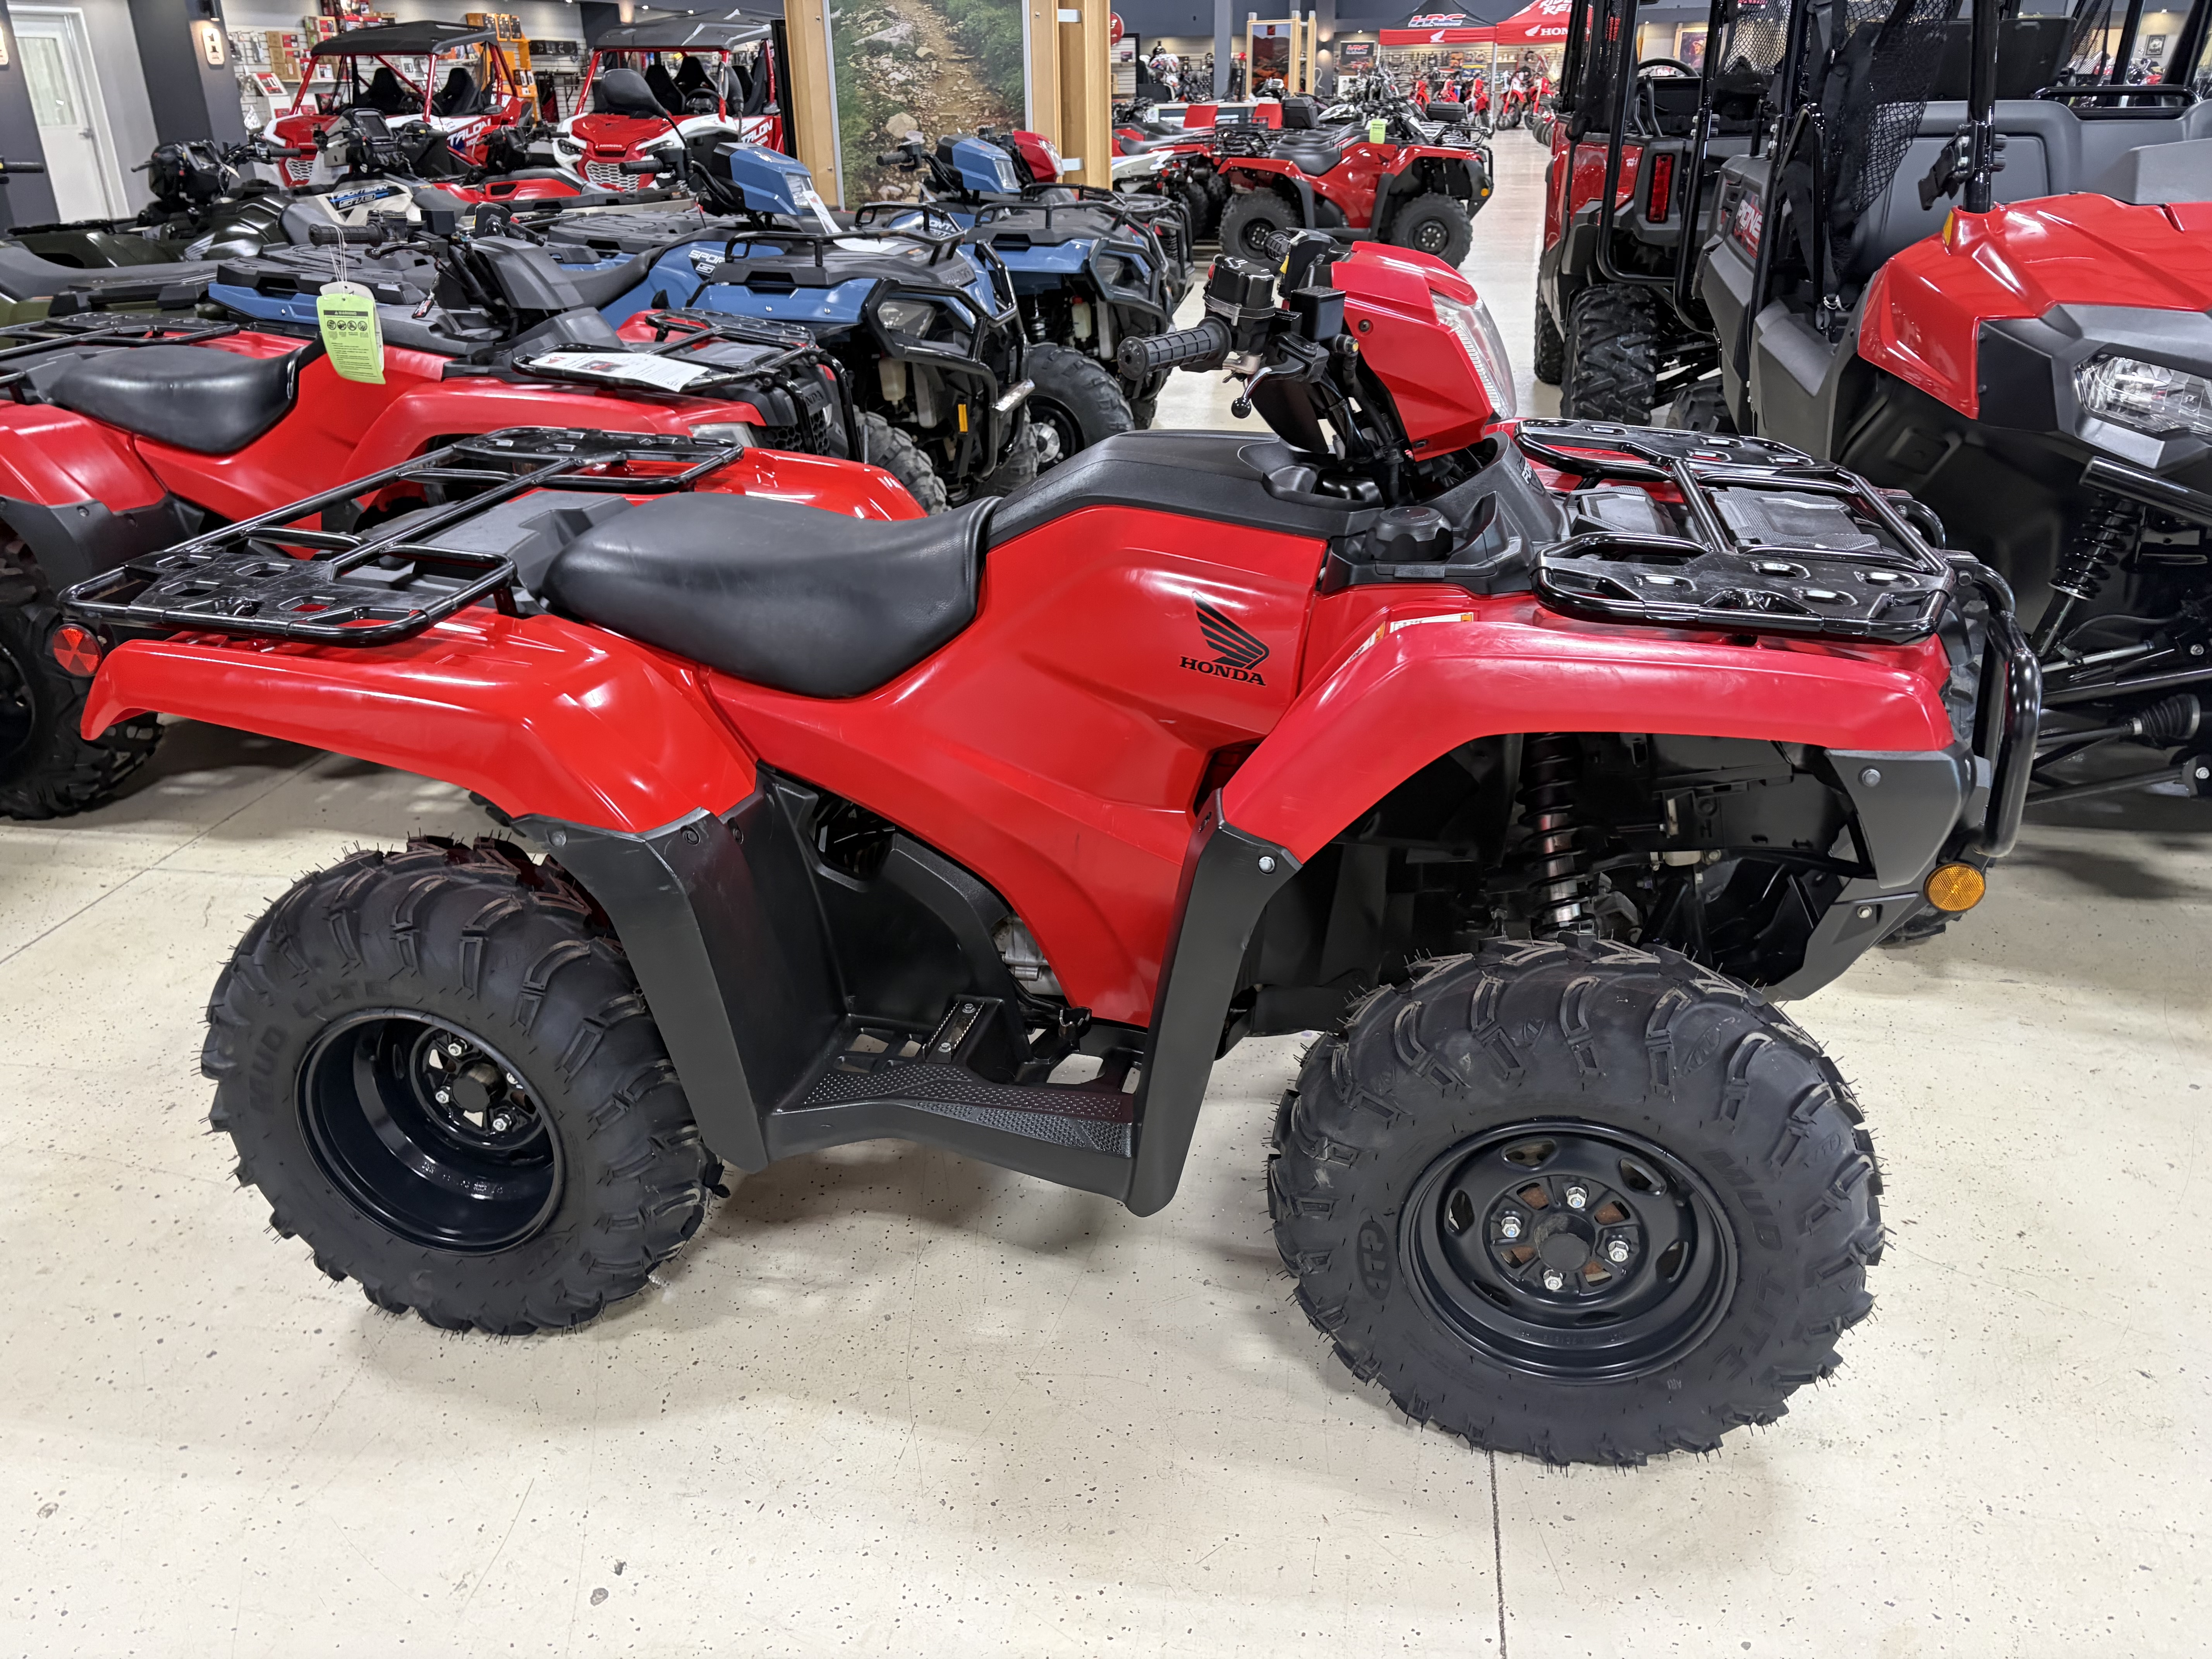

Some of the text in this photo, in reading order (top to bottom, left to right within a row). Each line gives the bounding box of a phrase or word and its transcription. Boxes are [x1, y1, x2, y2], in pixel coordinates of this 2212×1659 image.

[1408, 14, 1467, 26] HRC
[1540, 27, 1568, 36] HON
[741, 118, 773, 144] TALON
[1736, 199, 1762, 239] PIONE
[688, 250, 725, 264] SPOR
[1180, 656, 1266, 687] HONDA
[1361, 1229, 1389, 1290] ITP
[1699, 1147, 1786, 1381] MUD LITE
